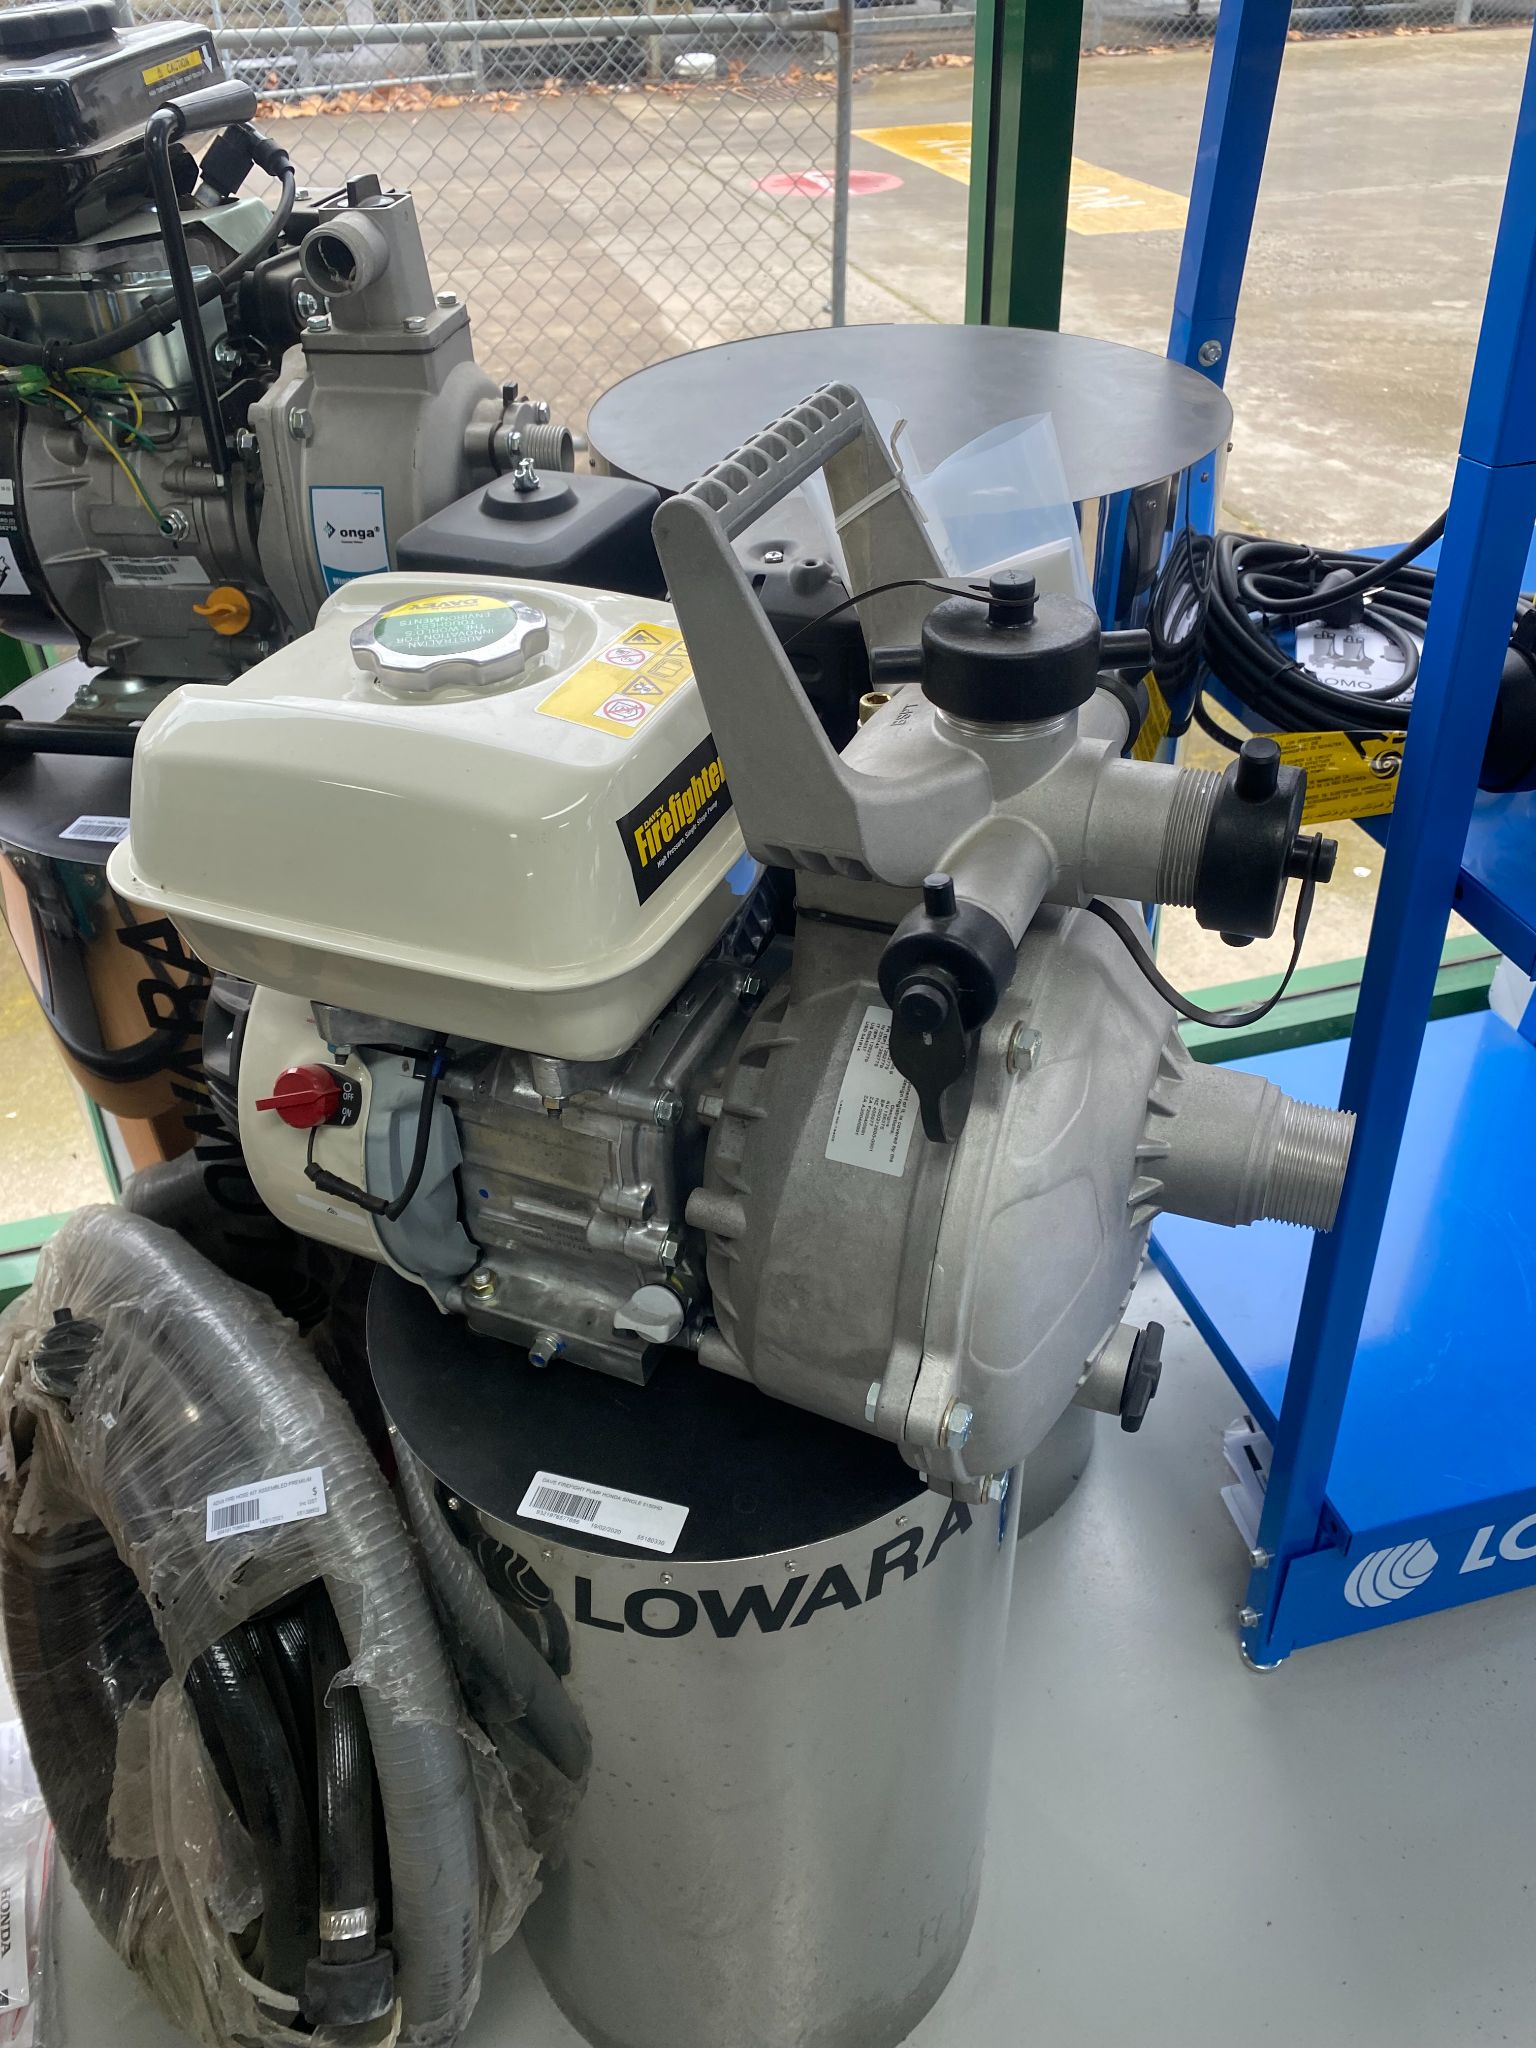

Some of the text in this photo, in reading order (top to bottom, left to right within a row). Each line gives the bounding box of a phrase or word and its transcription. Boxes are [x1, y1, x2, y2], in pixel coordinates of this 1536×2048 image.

[409, 599, 480, 610] DAVEY
[400, 612, 491, 626] ENVIRONMENTS
[416, 620, 476, 630] TOUGHEST
[396, 628, 494, 644] INNOVATION FOR
[408, 636, 483, 648] AUSTRALIAN
[644, 804, 665, 829] DAVEY
[343, 1092, 354, 1101] OFF
[341, 1107, 352, 1117] ON
[312, 1486, 318, 1496] $
[558, 1480, 585, 1492] FIREFIGHT
[586, 1487, 602, 1496] PUMP
[602, 1491, 621, 1501] HONDA
[622, 1497, 642, 1506] SINGLE
[574, 1499, 973, 1638] LOWARA
[0, 1887, 11, 1959] HONDA
